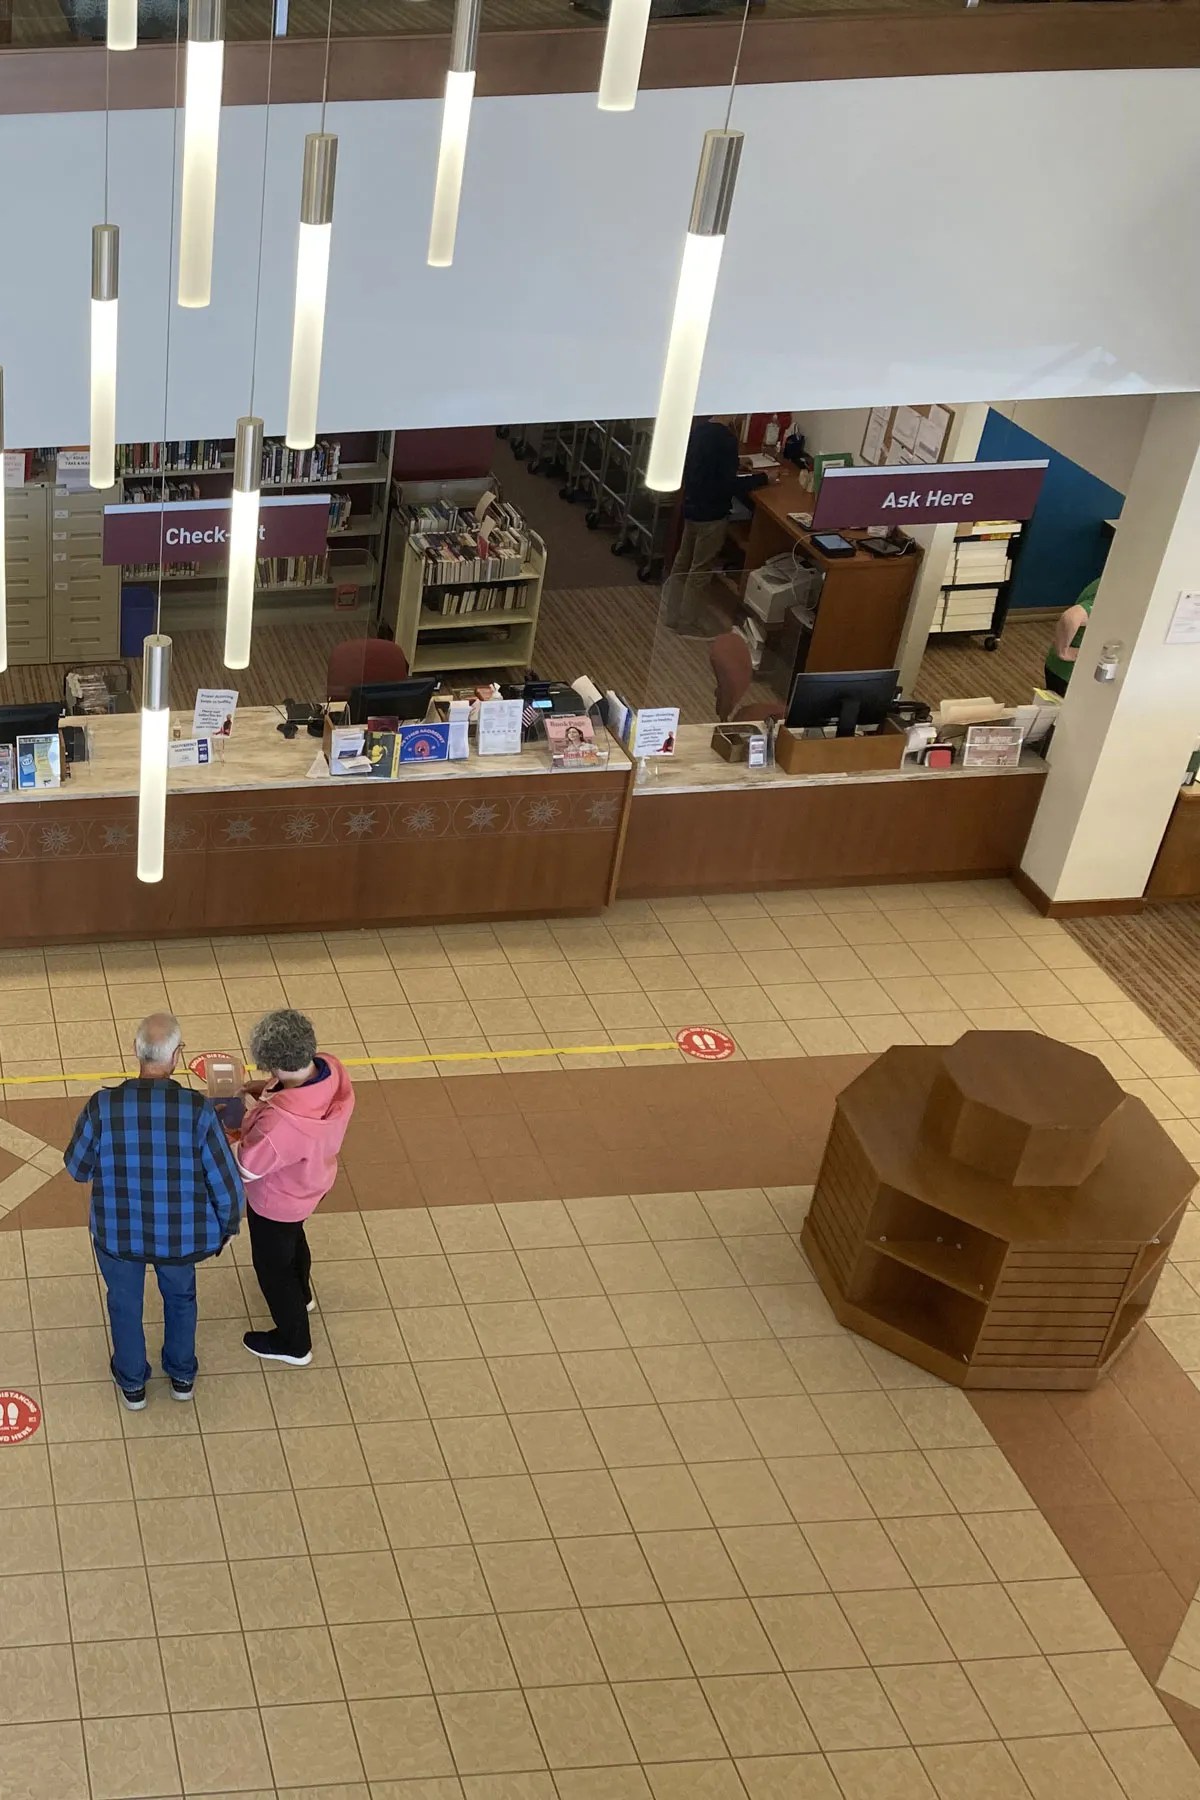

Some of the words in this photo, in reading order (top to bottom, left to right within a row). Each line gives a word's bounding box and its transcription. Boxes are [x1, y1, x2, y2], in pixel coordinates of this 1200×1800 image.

[881, 491, 921, 509] Ask
[926, 489, 974, 507] Here
[165, 524, 266, 546] Check-t
[11, 1426, 33, 1442] HERE
